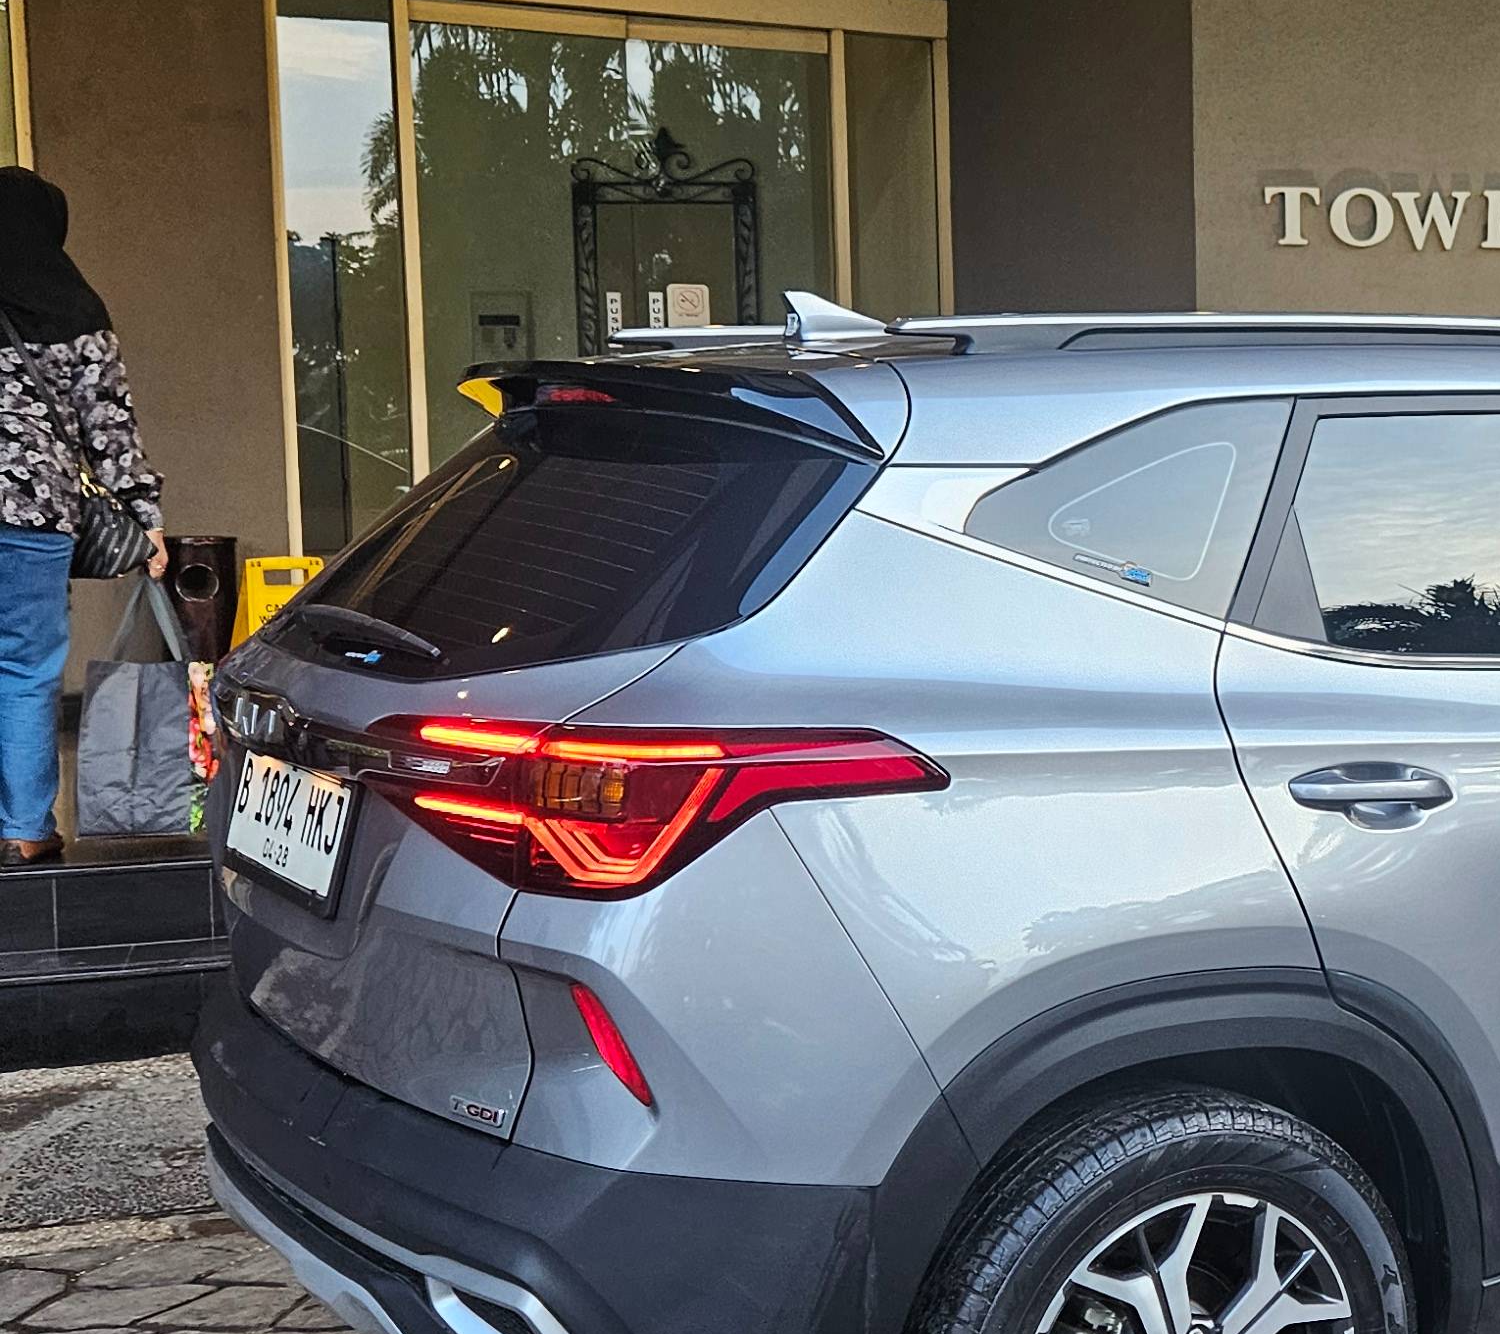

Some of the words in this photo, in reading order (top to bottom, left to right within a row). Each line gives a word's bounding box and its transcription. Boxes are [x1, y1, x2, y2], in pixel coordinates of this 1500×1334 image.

[237, 757, 254, 814] B
[254, 766, 302, 836] 1894
[300, 785, 345, 856] HKJ
